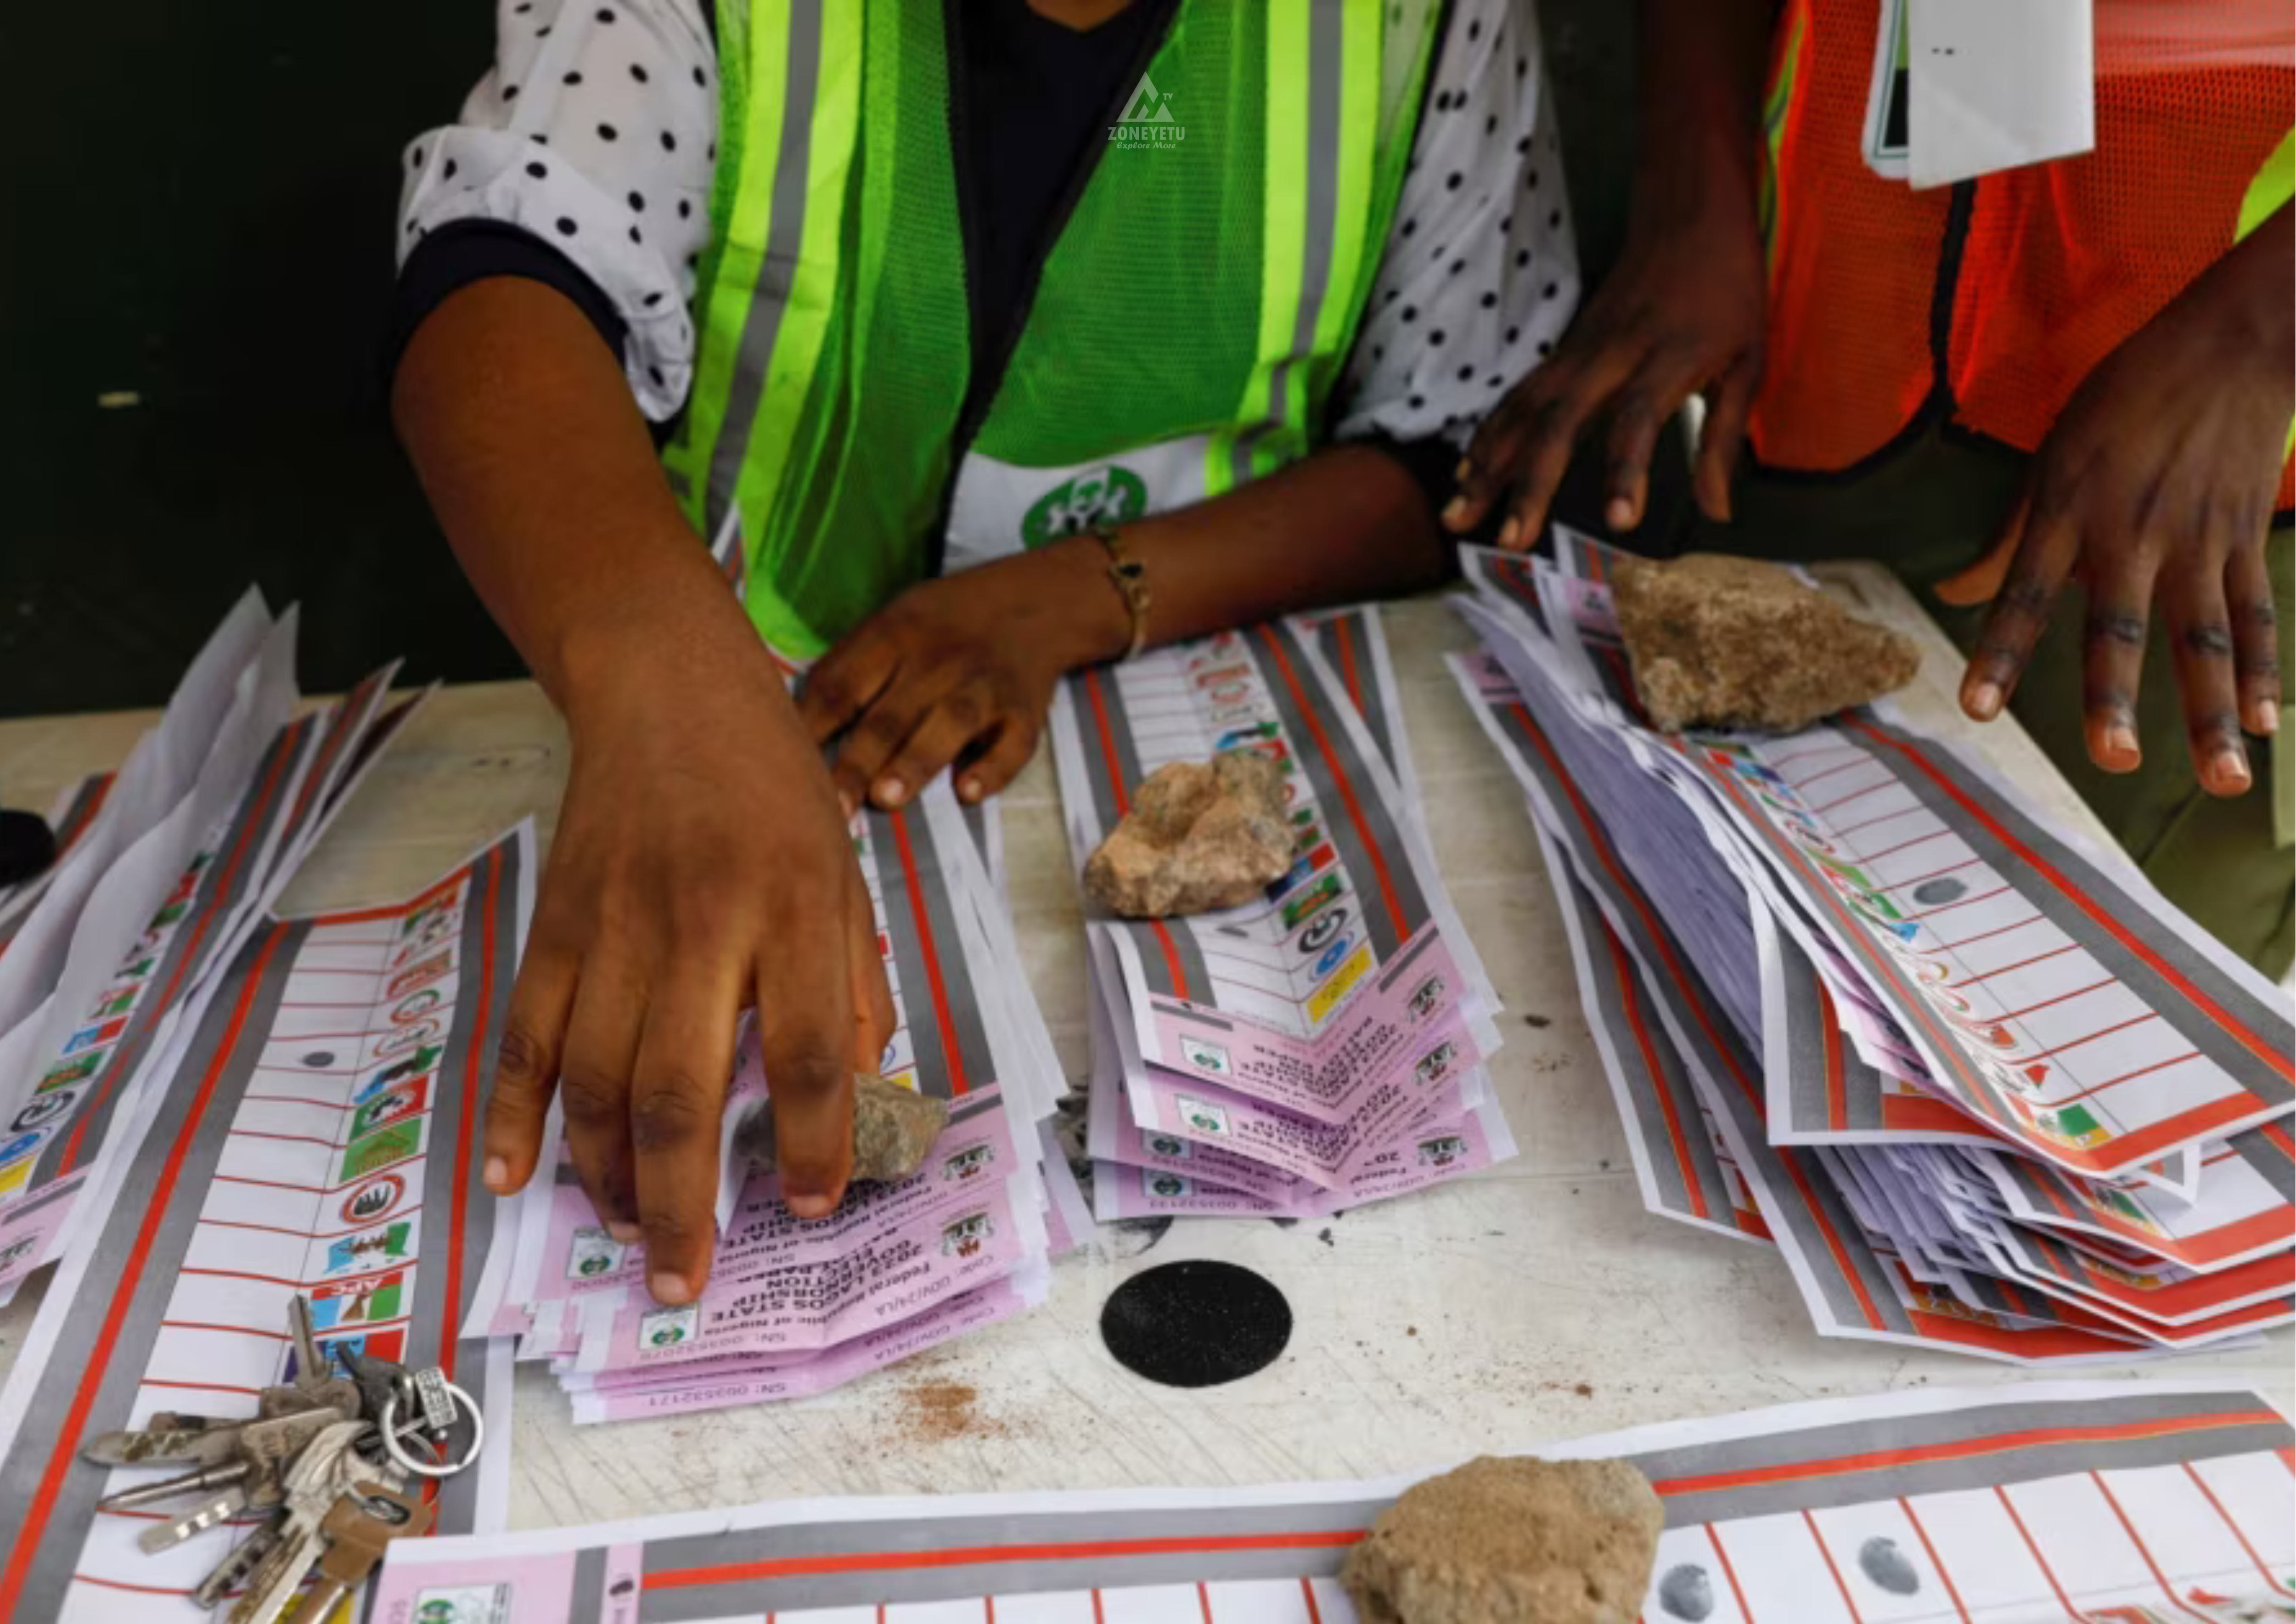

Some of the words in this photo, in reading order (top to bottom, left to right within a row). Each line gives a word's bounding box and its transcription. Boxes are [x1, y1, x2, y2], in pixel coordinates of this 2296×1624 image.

[1364, 1150, 1401, 1167] 20
[955, 1254, 994, 1279] Code:
[869, 1262, 931, 1295] Federal
[875, 1275, 951, 1316] GOV/24/LA
[710, 1300, 785, 1323] STATE
[773, 1316, 793, 1327] of
[703, 1318, 768, 1337] Nigeria
